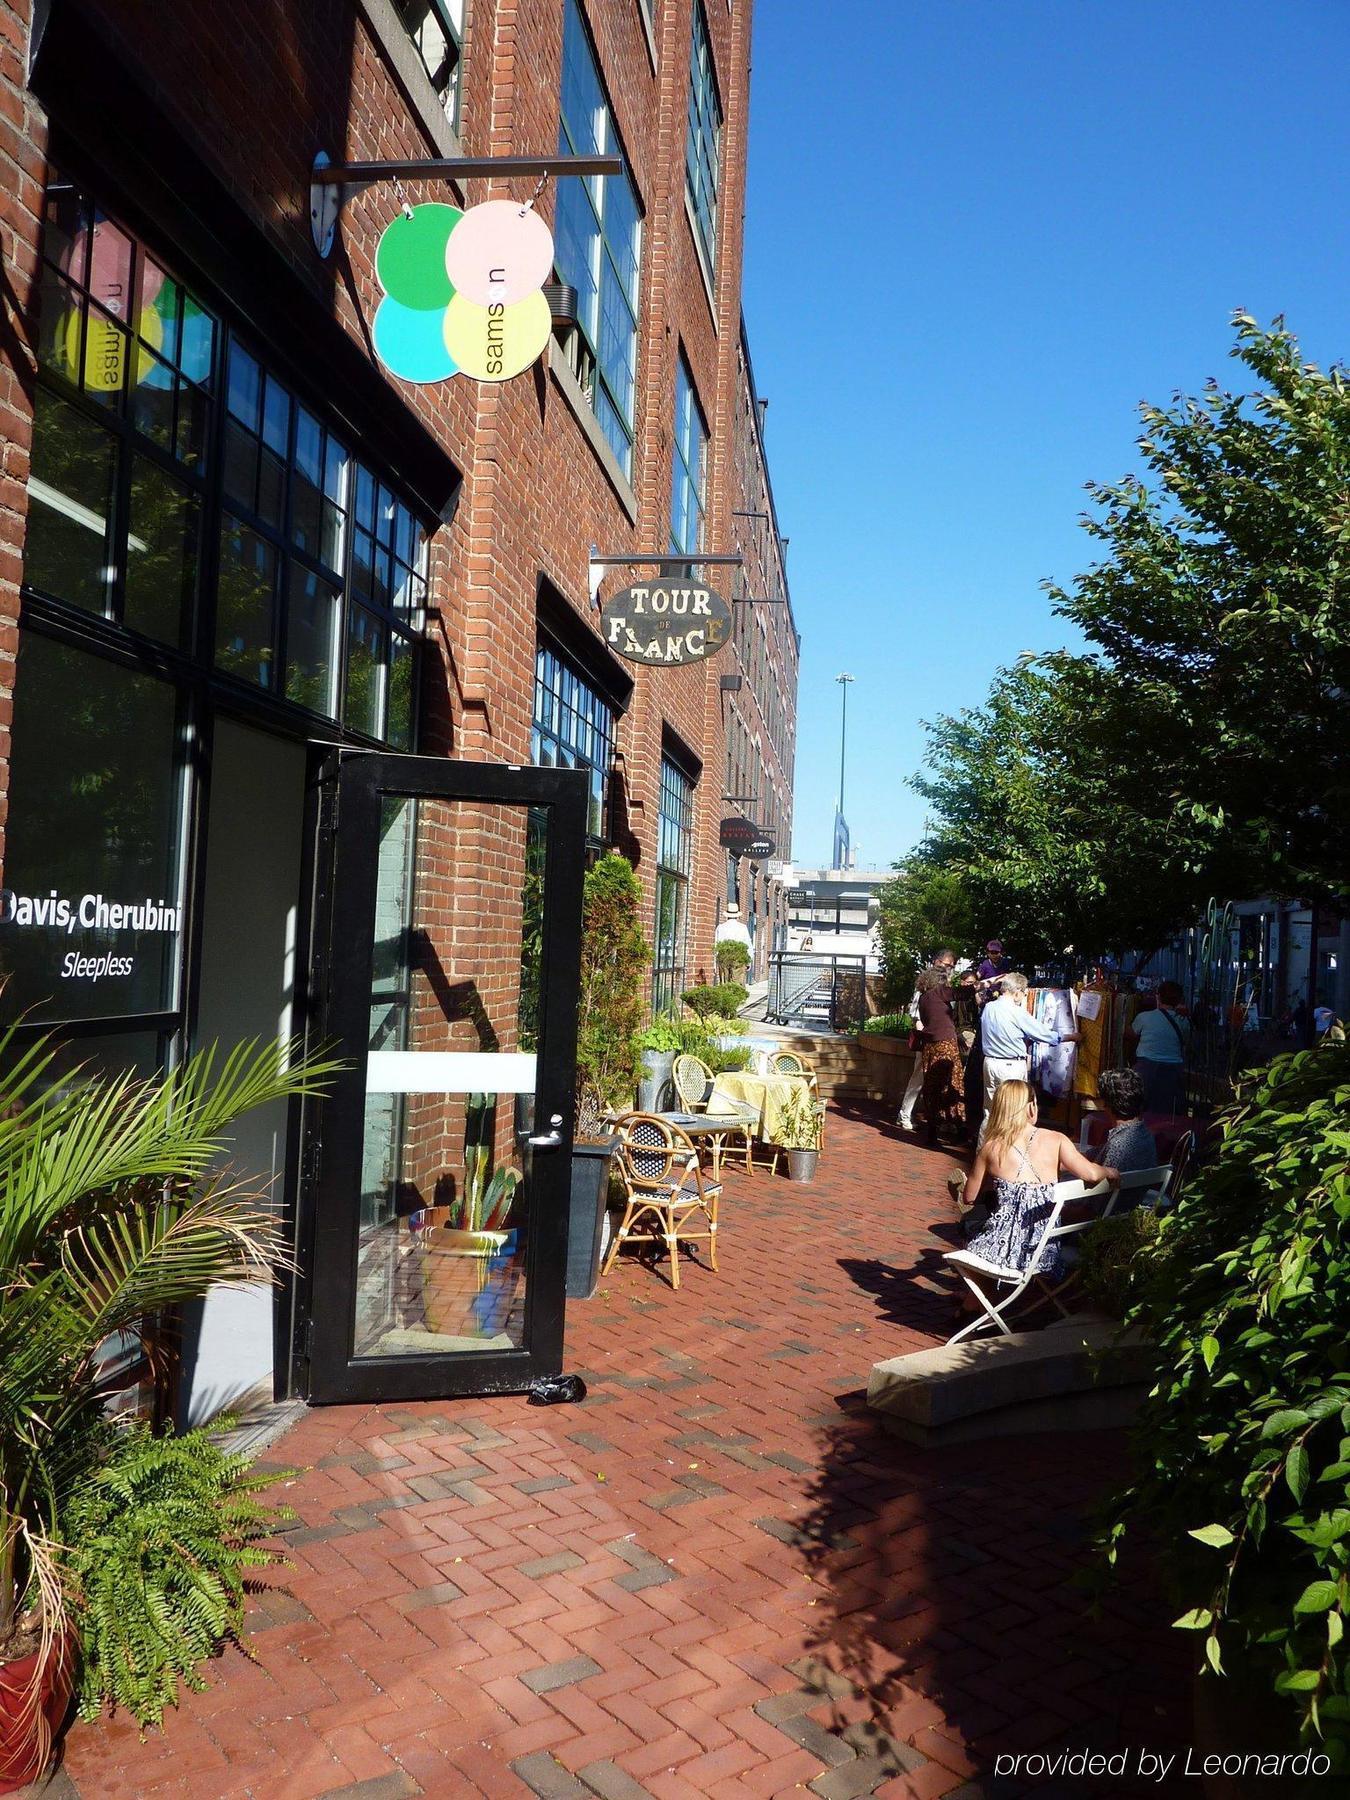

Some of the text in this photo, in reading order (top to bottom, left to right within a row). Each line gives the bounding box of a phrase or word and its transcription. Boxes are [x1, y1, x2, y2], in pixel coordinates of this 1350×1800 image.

[487, 268, 506, 375] samson
[630, 588, 712, 615] TOUR
[608, 617, 724, 662] FRANCE
[658, 620, 671, 630] DE
[79, 894, 182, 932] Cherubini
[61, 951, 134, 983] Sleepless
